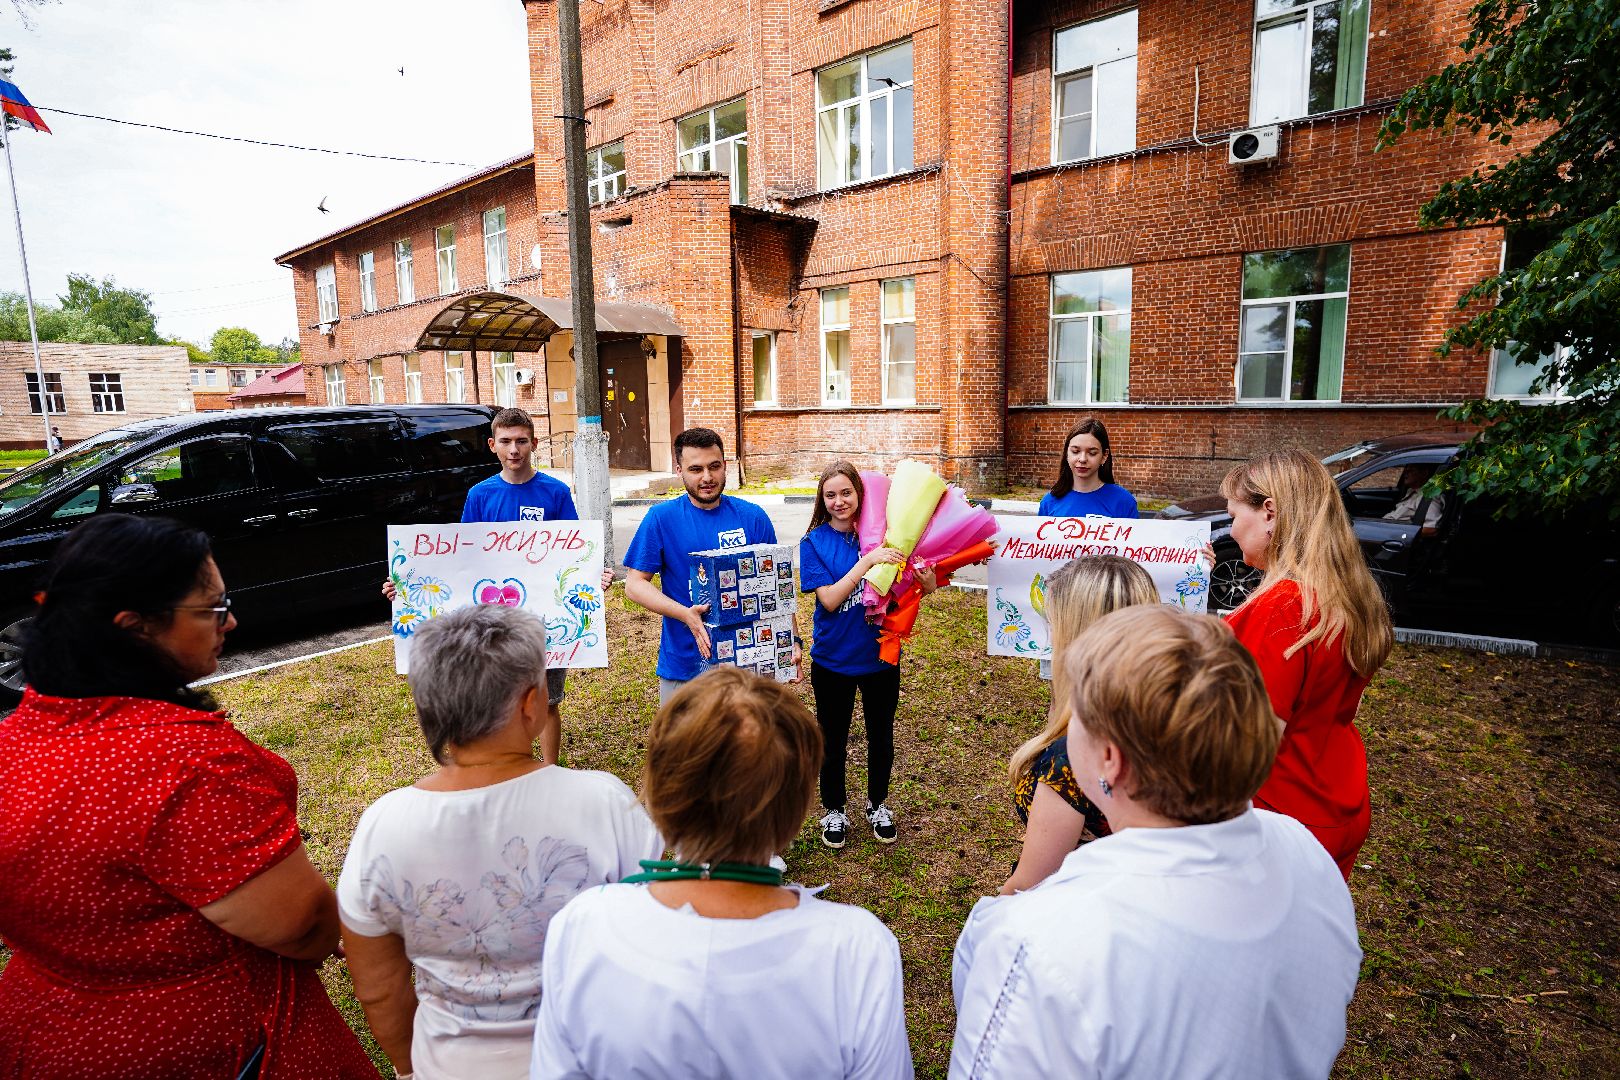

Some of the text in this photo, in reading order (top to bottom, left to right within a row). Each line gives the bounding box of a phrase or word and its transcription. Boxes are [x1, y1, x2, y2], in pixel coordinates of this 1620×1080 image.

[1036, 517, 1132, 541] С ДНЁМ
[482, 529, 585, 564] ЖИЗНЬ
